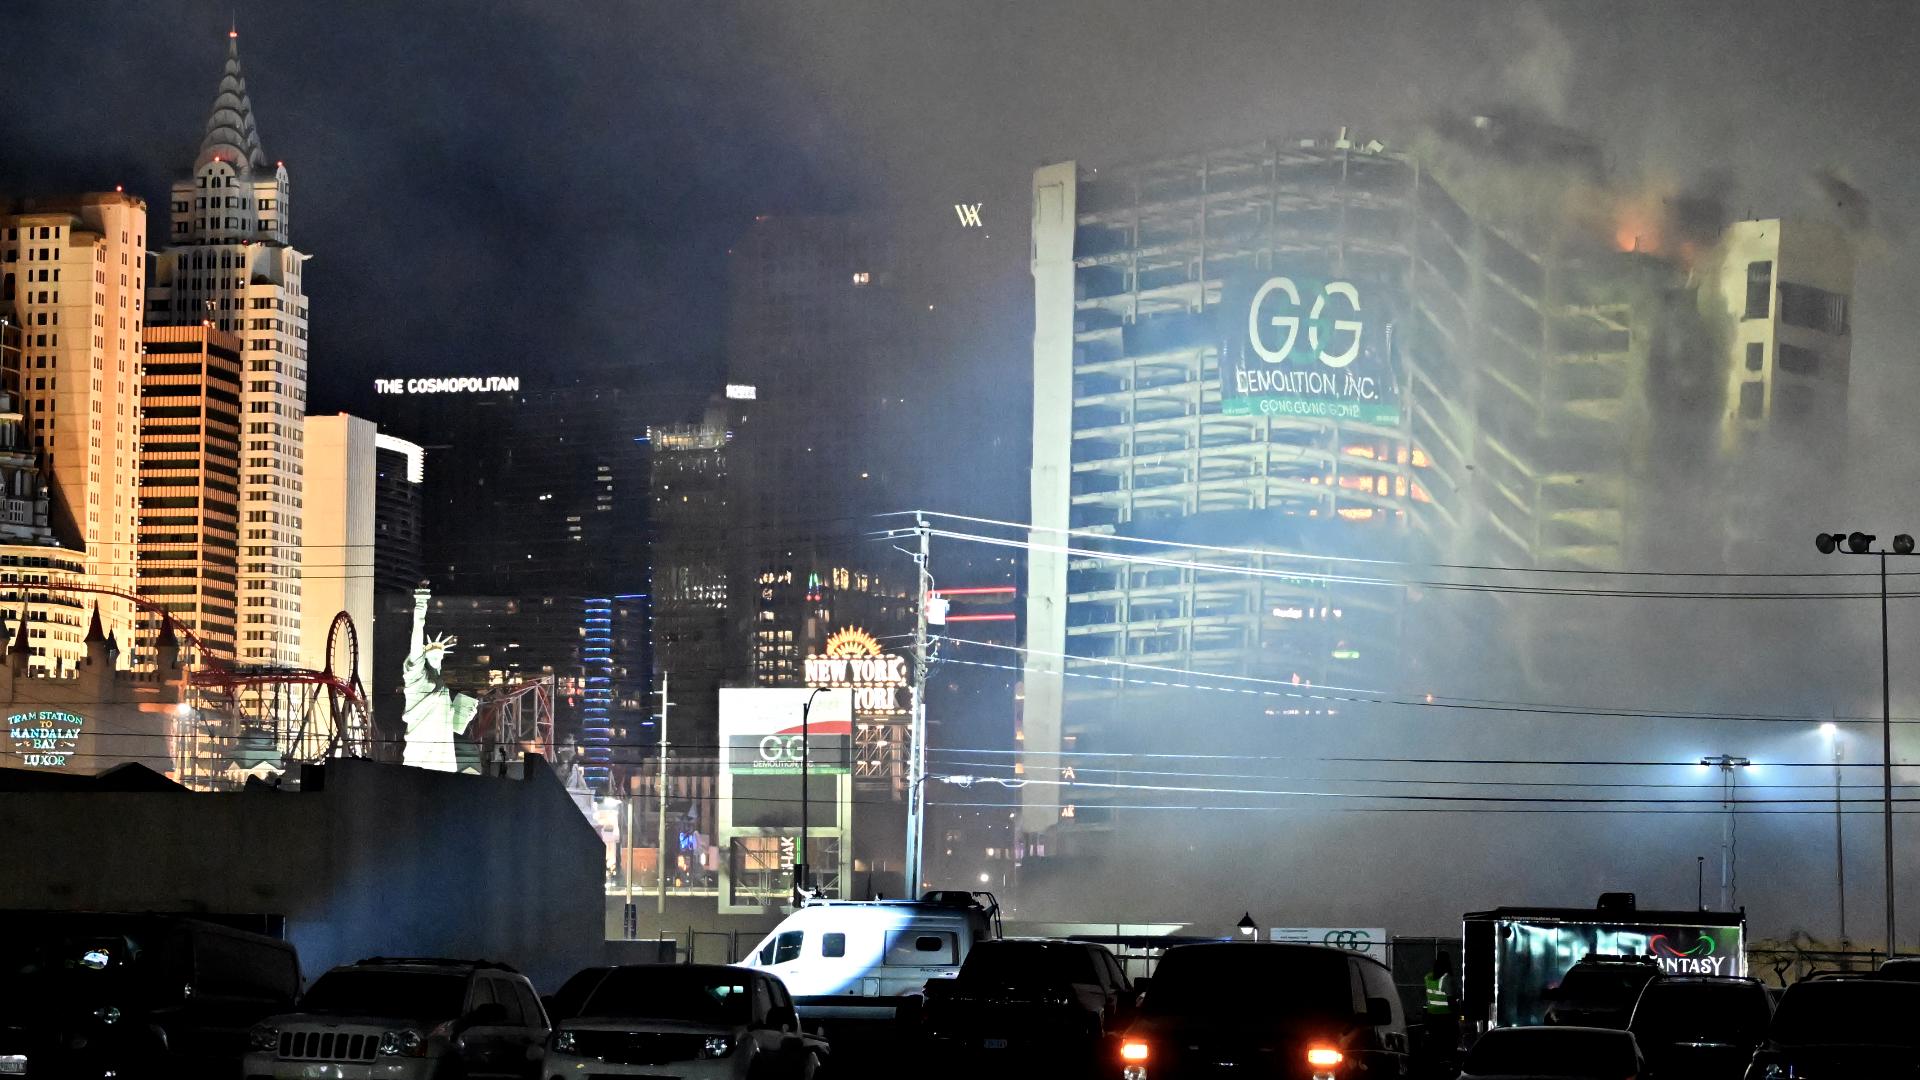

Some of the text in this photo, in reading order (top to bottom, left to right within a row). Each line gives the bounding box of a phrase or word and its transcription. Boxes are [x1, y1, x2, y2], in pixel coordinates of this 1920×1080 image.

[375, 377, 519, 394] THE COSMOPOLITAN
[805, 659, 902, 682] NEW YORK
[8, 711, 83, 725] TRAM STATION
[40, 720, 52, 728] TO
[11, 728, 80, 739] MANDALAY
[33, 739, 56, 749] BAY
[24, 755, 65, 766] LUXOR
[1650, 954, 1726, 977] ANTASY
